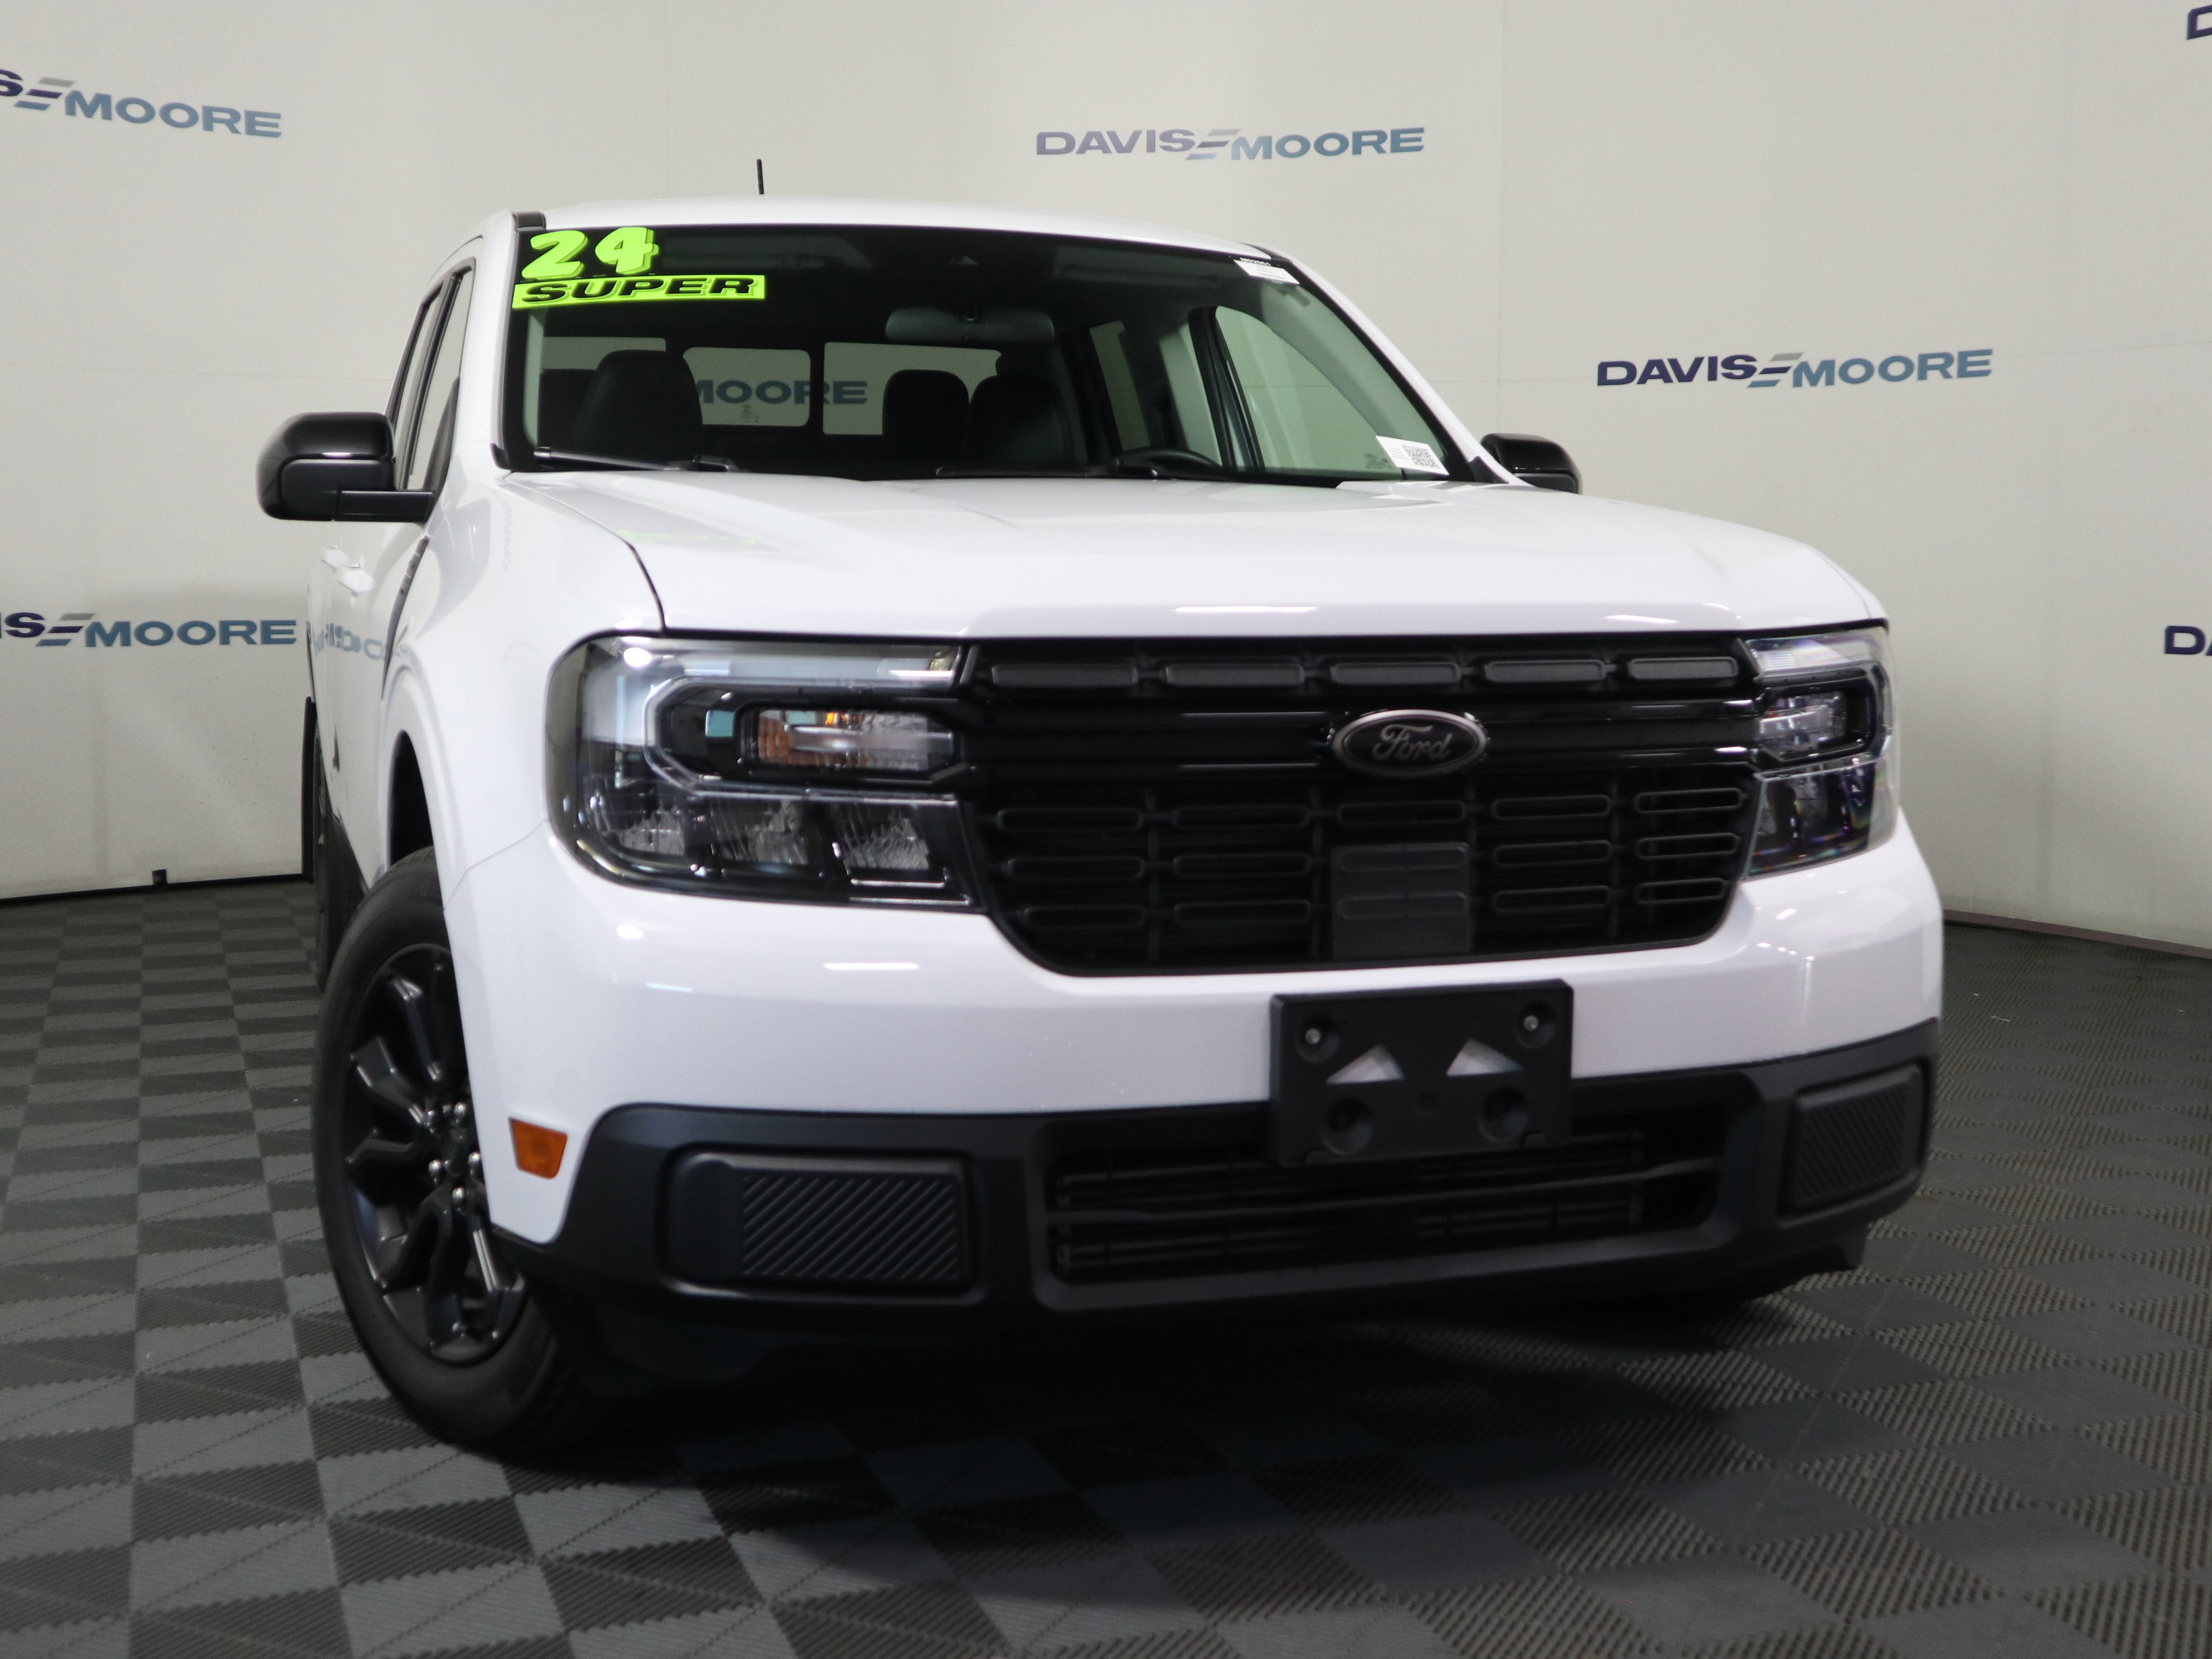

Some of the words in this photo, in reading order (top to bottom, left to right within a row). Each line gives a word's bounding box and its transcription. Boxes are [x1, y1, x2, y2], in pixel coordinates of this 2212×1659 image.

[64, 89, 281, 138] MOORE
[1036, 128, 1196, 156] DAVIS
[1230, 127, 1425, 161] MOORE
[521, 227, 660, 280] 24
[521, 276, 761, 304] SUPER
[1597, 354, 1757, 386] DAVIS
[1792, 348, 1993, 388] MOORE
[85, 620, 296, 647] MOORE
[1373, 724, 1454, 762] Ford
